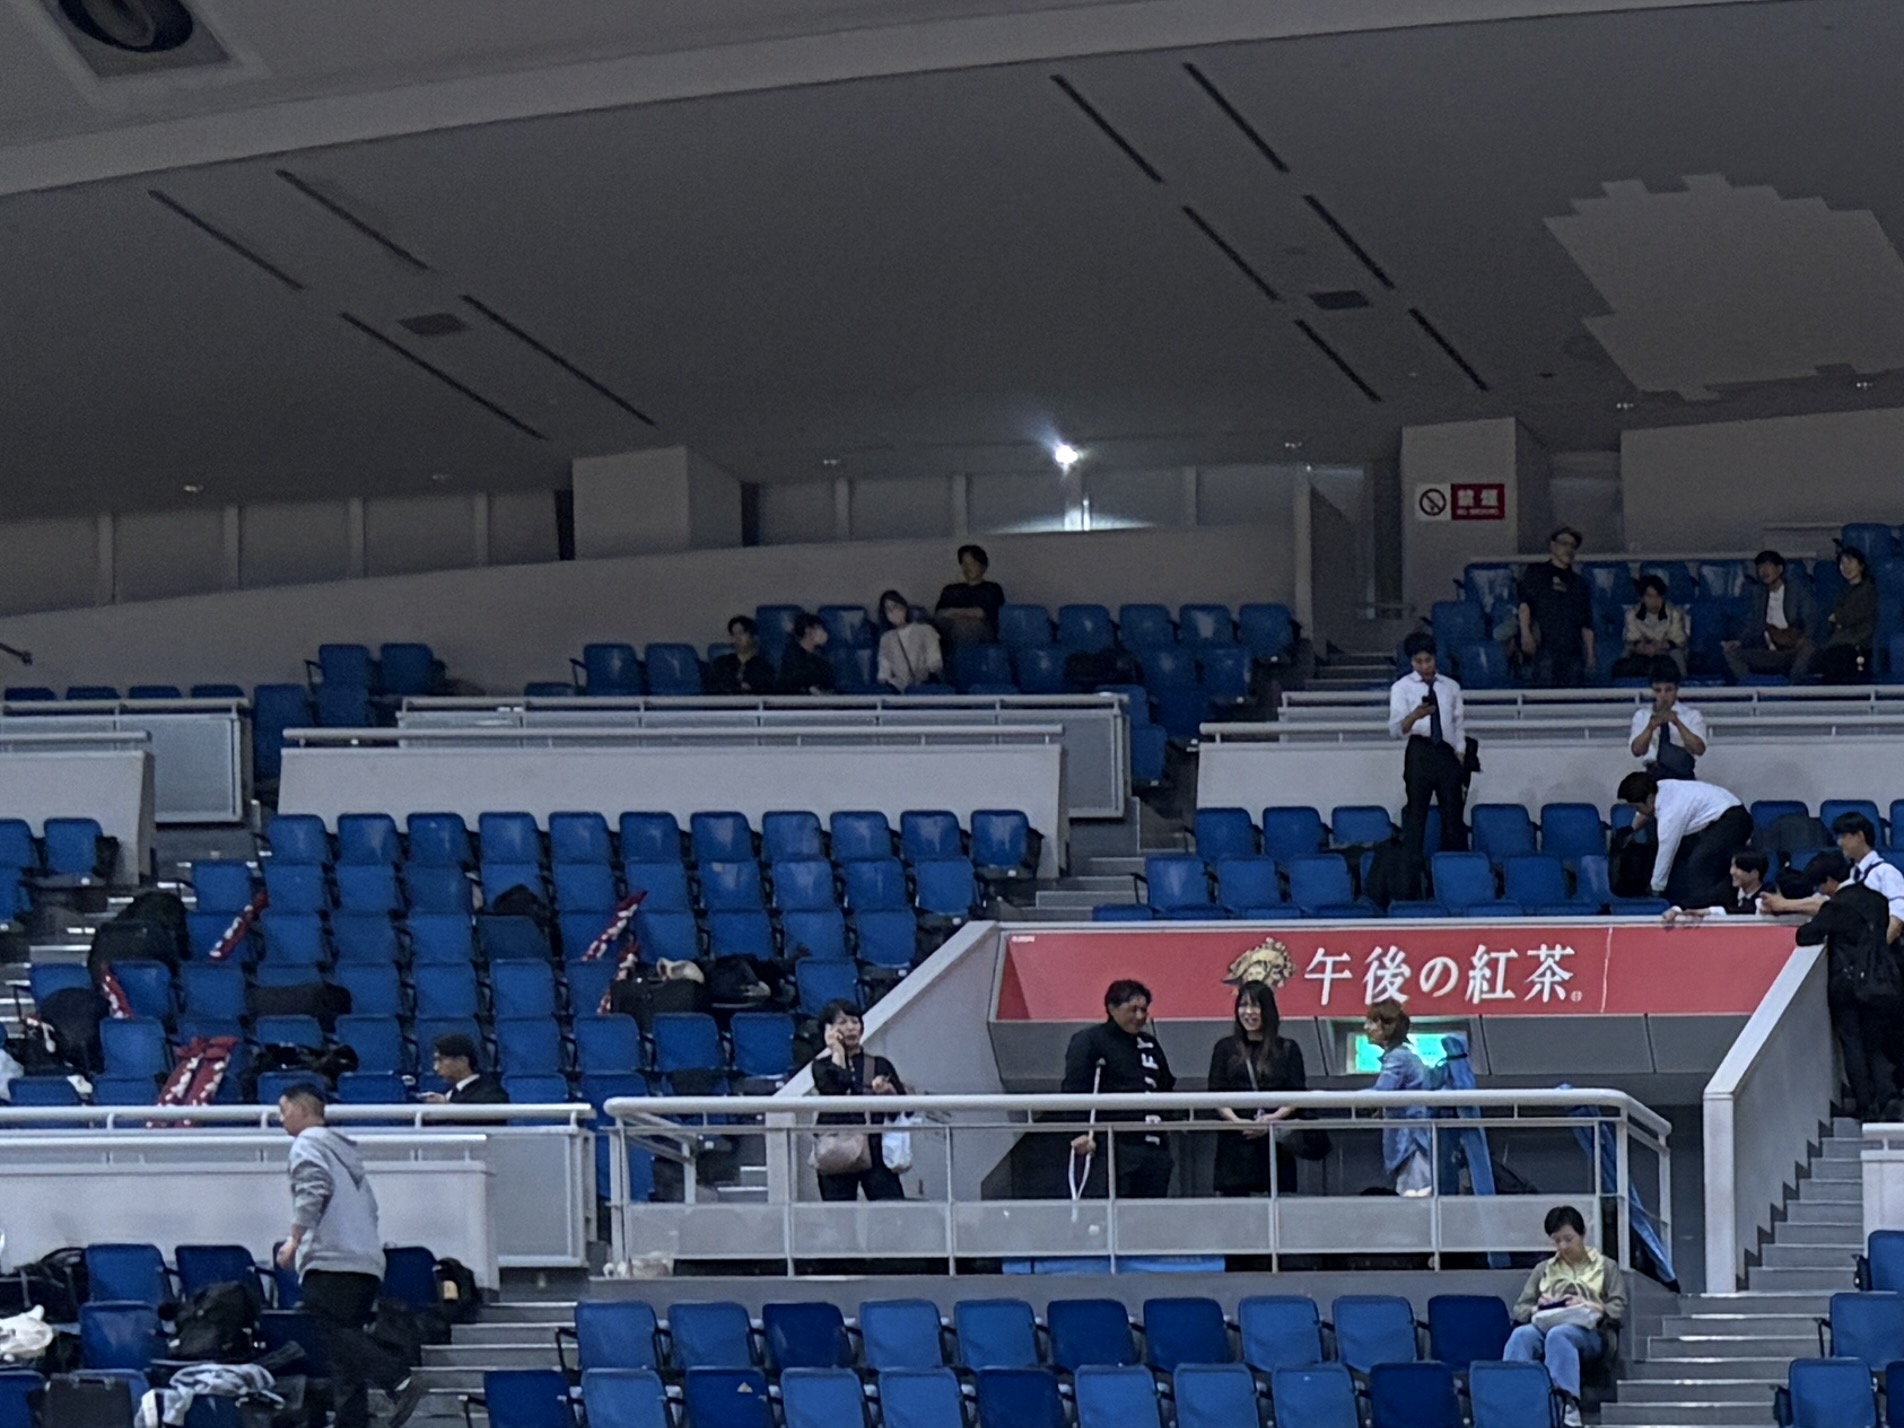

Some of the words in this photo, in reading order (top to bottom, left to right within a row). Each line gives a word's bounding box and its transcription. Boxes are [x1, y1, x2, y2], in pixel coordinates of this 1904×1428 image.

[1303, 943, 1577, 1005] 午後の紅茶
